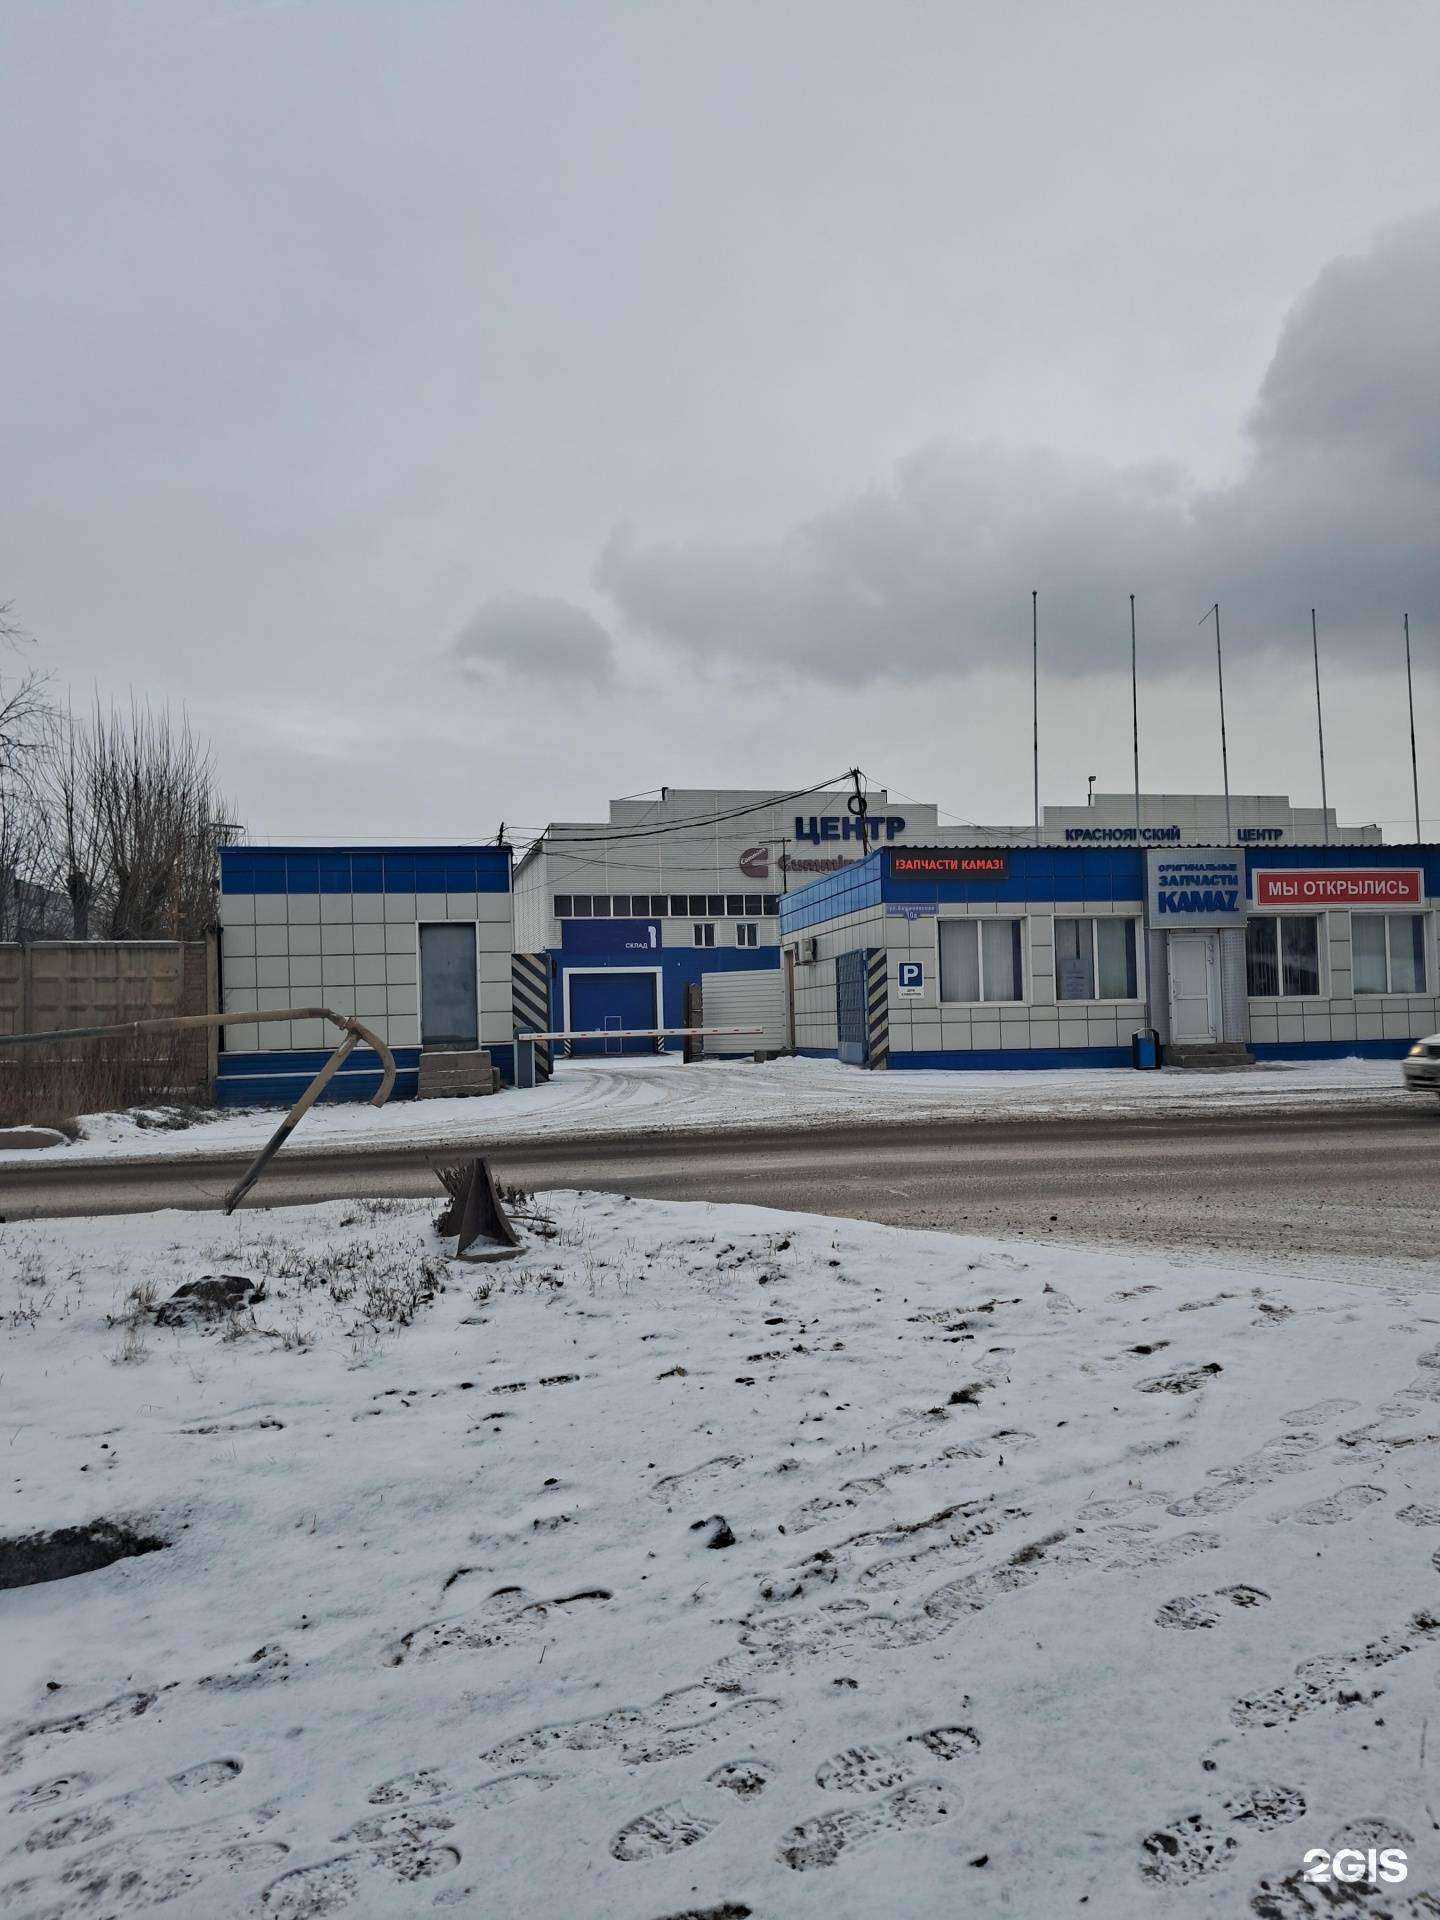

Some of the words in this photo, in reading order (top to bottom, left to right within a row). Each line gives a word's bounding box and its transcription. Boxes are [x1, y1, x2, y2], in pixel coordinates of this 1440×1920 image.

[795, 816, 906, 845] ЦЕНТР
[1237, 828, 1284, 842] ЦЕНТР
[777, 854, 863, 872] Cummi
[895, 859, 958, 870] !ЗАПЧАСТИ
[961, 859, 1004, 870] КАМАЗ!
[1158, 863, 1237, 872] ОРИГИНАЛЬНЫЕ
[1158, 874, 1239, 886] ЗАПЧАСТИ
[1268, 881, 1298, 896] МЫ
[1303, 880, 1410, 896] ОТКРЫЛИСЬ
[1158, 890, 1240, 913] KAMAZ
[625, 942, 649, 950] СКЛАД
[647, 925, 657, 949] 1
